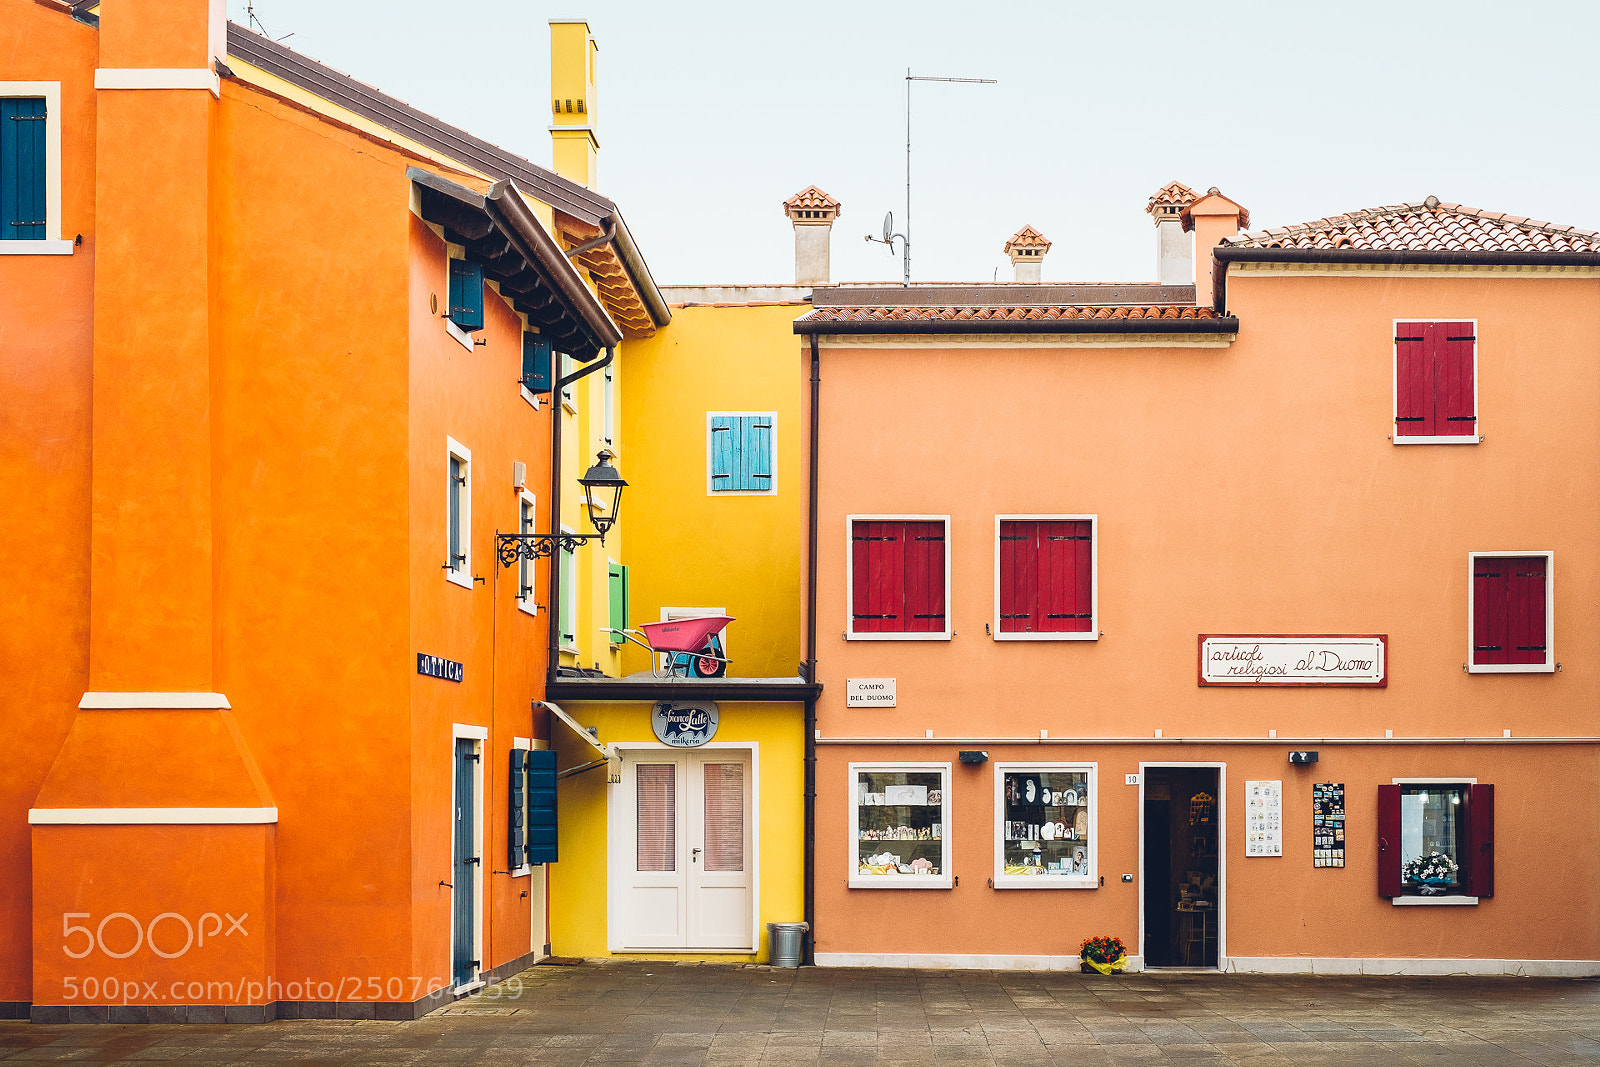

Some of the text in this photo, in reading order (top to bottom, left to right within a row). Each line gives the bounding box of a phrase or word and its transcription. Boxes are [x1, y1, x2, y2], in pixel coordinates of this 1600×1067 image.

[1211, 644, 1264, 661] articoli
[1293, 650, 1374, 671] al Duomo
[1227, 660, 1288, 682] religiosi
[1128, 775, 1137, 784] 10
